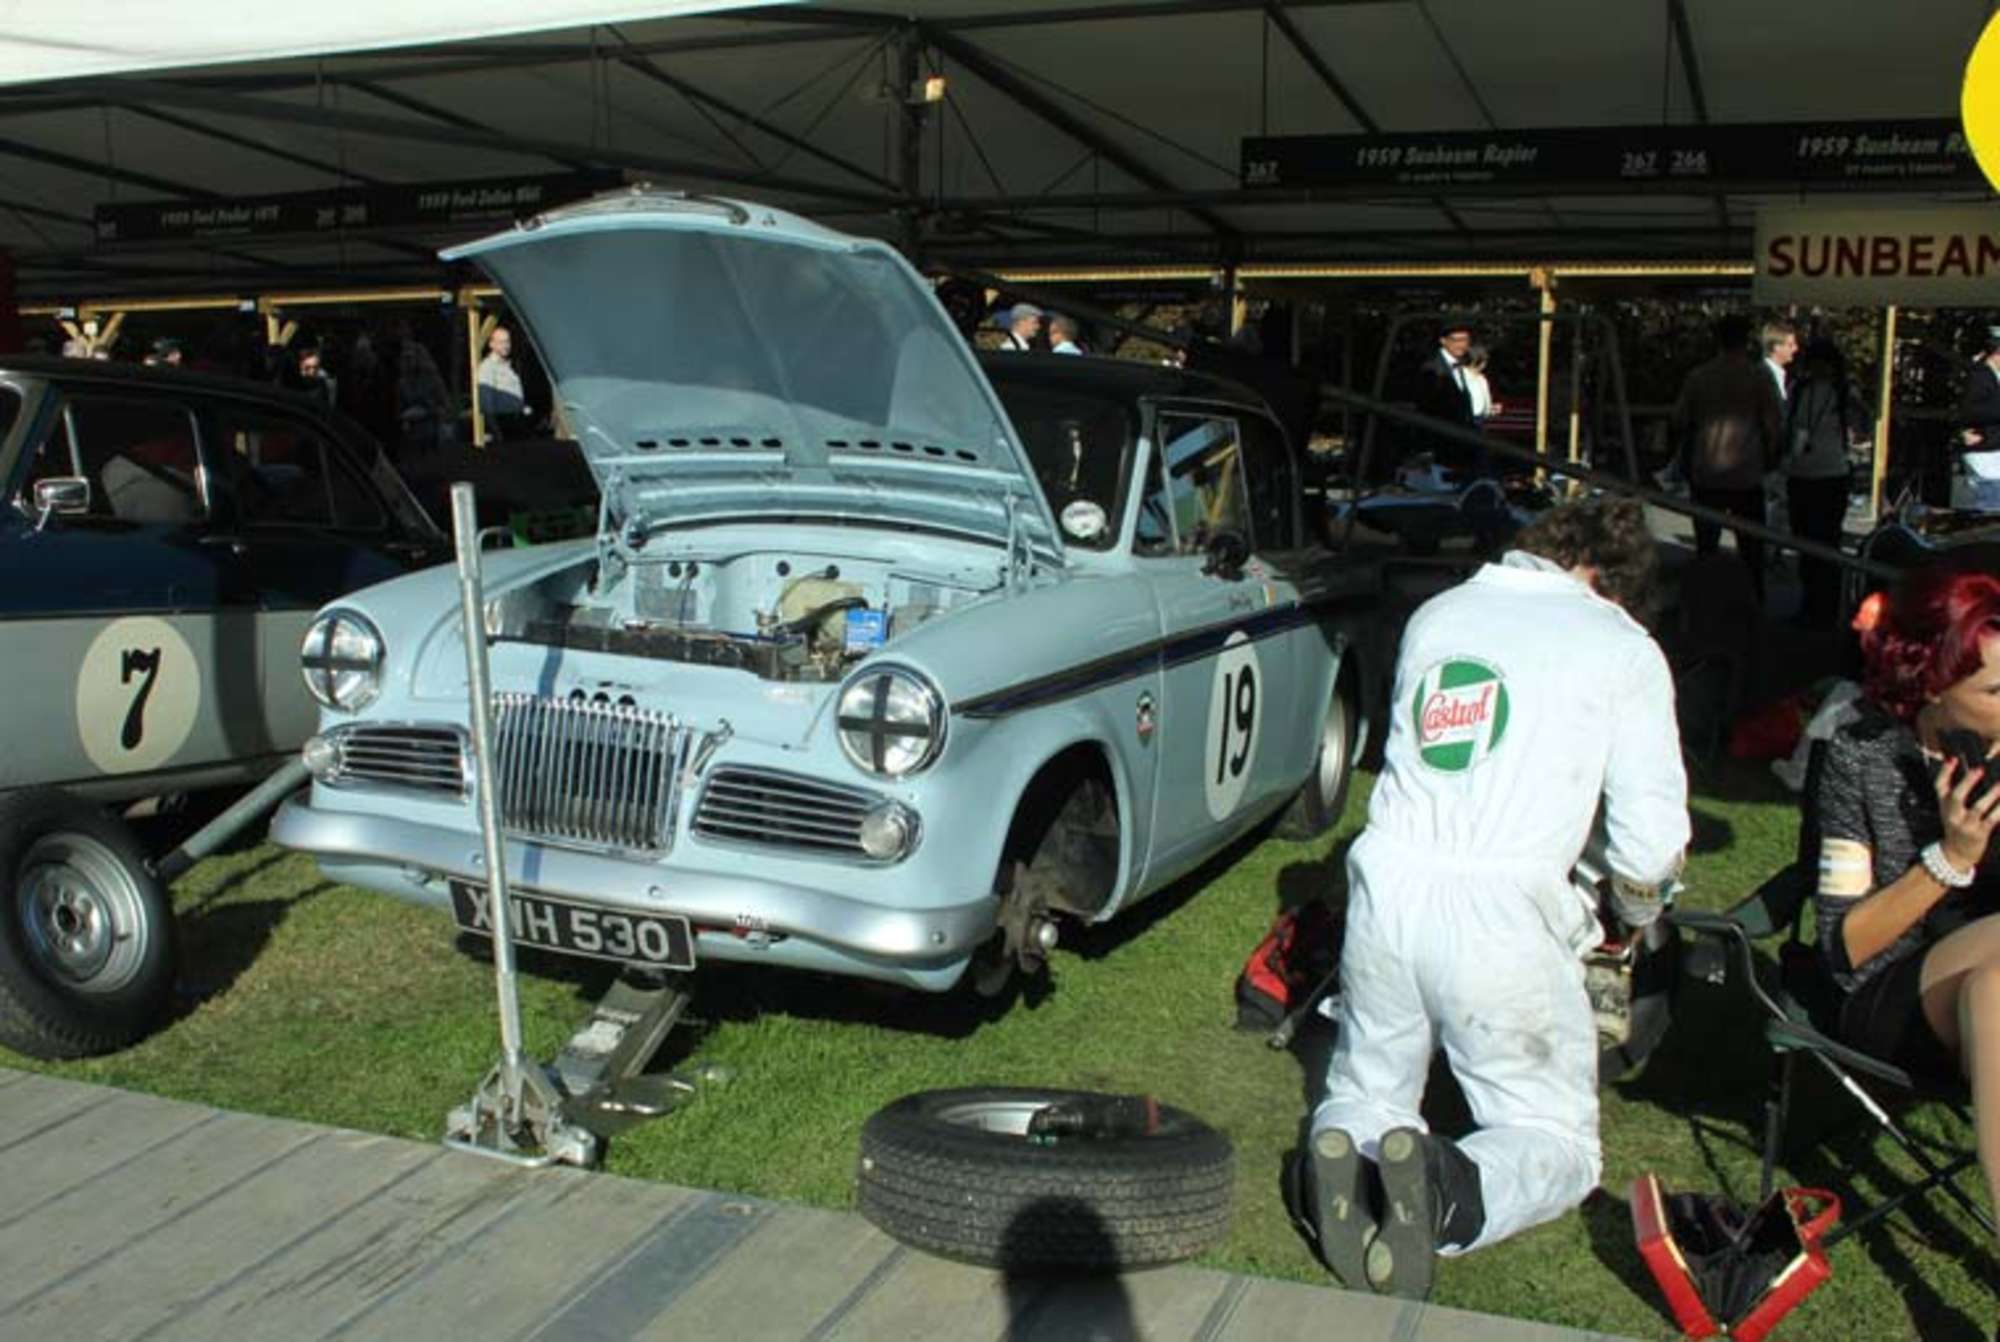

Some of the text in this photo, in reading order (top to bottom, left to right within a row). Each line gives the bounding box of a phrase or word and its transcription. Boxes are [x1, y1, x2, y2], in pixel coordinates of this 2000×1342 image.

[1356, 147, 1402, 166] 1959
[1798, 136, 1850, 157] 1959
[120, 647, 161, 751] 7
[1216, 664, 1256, 785] 19
[1421, 684, 1493, 742] Castrol
[569, 909, 671, 962] 530
